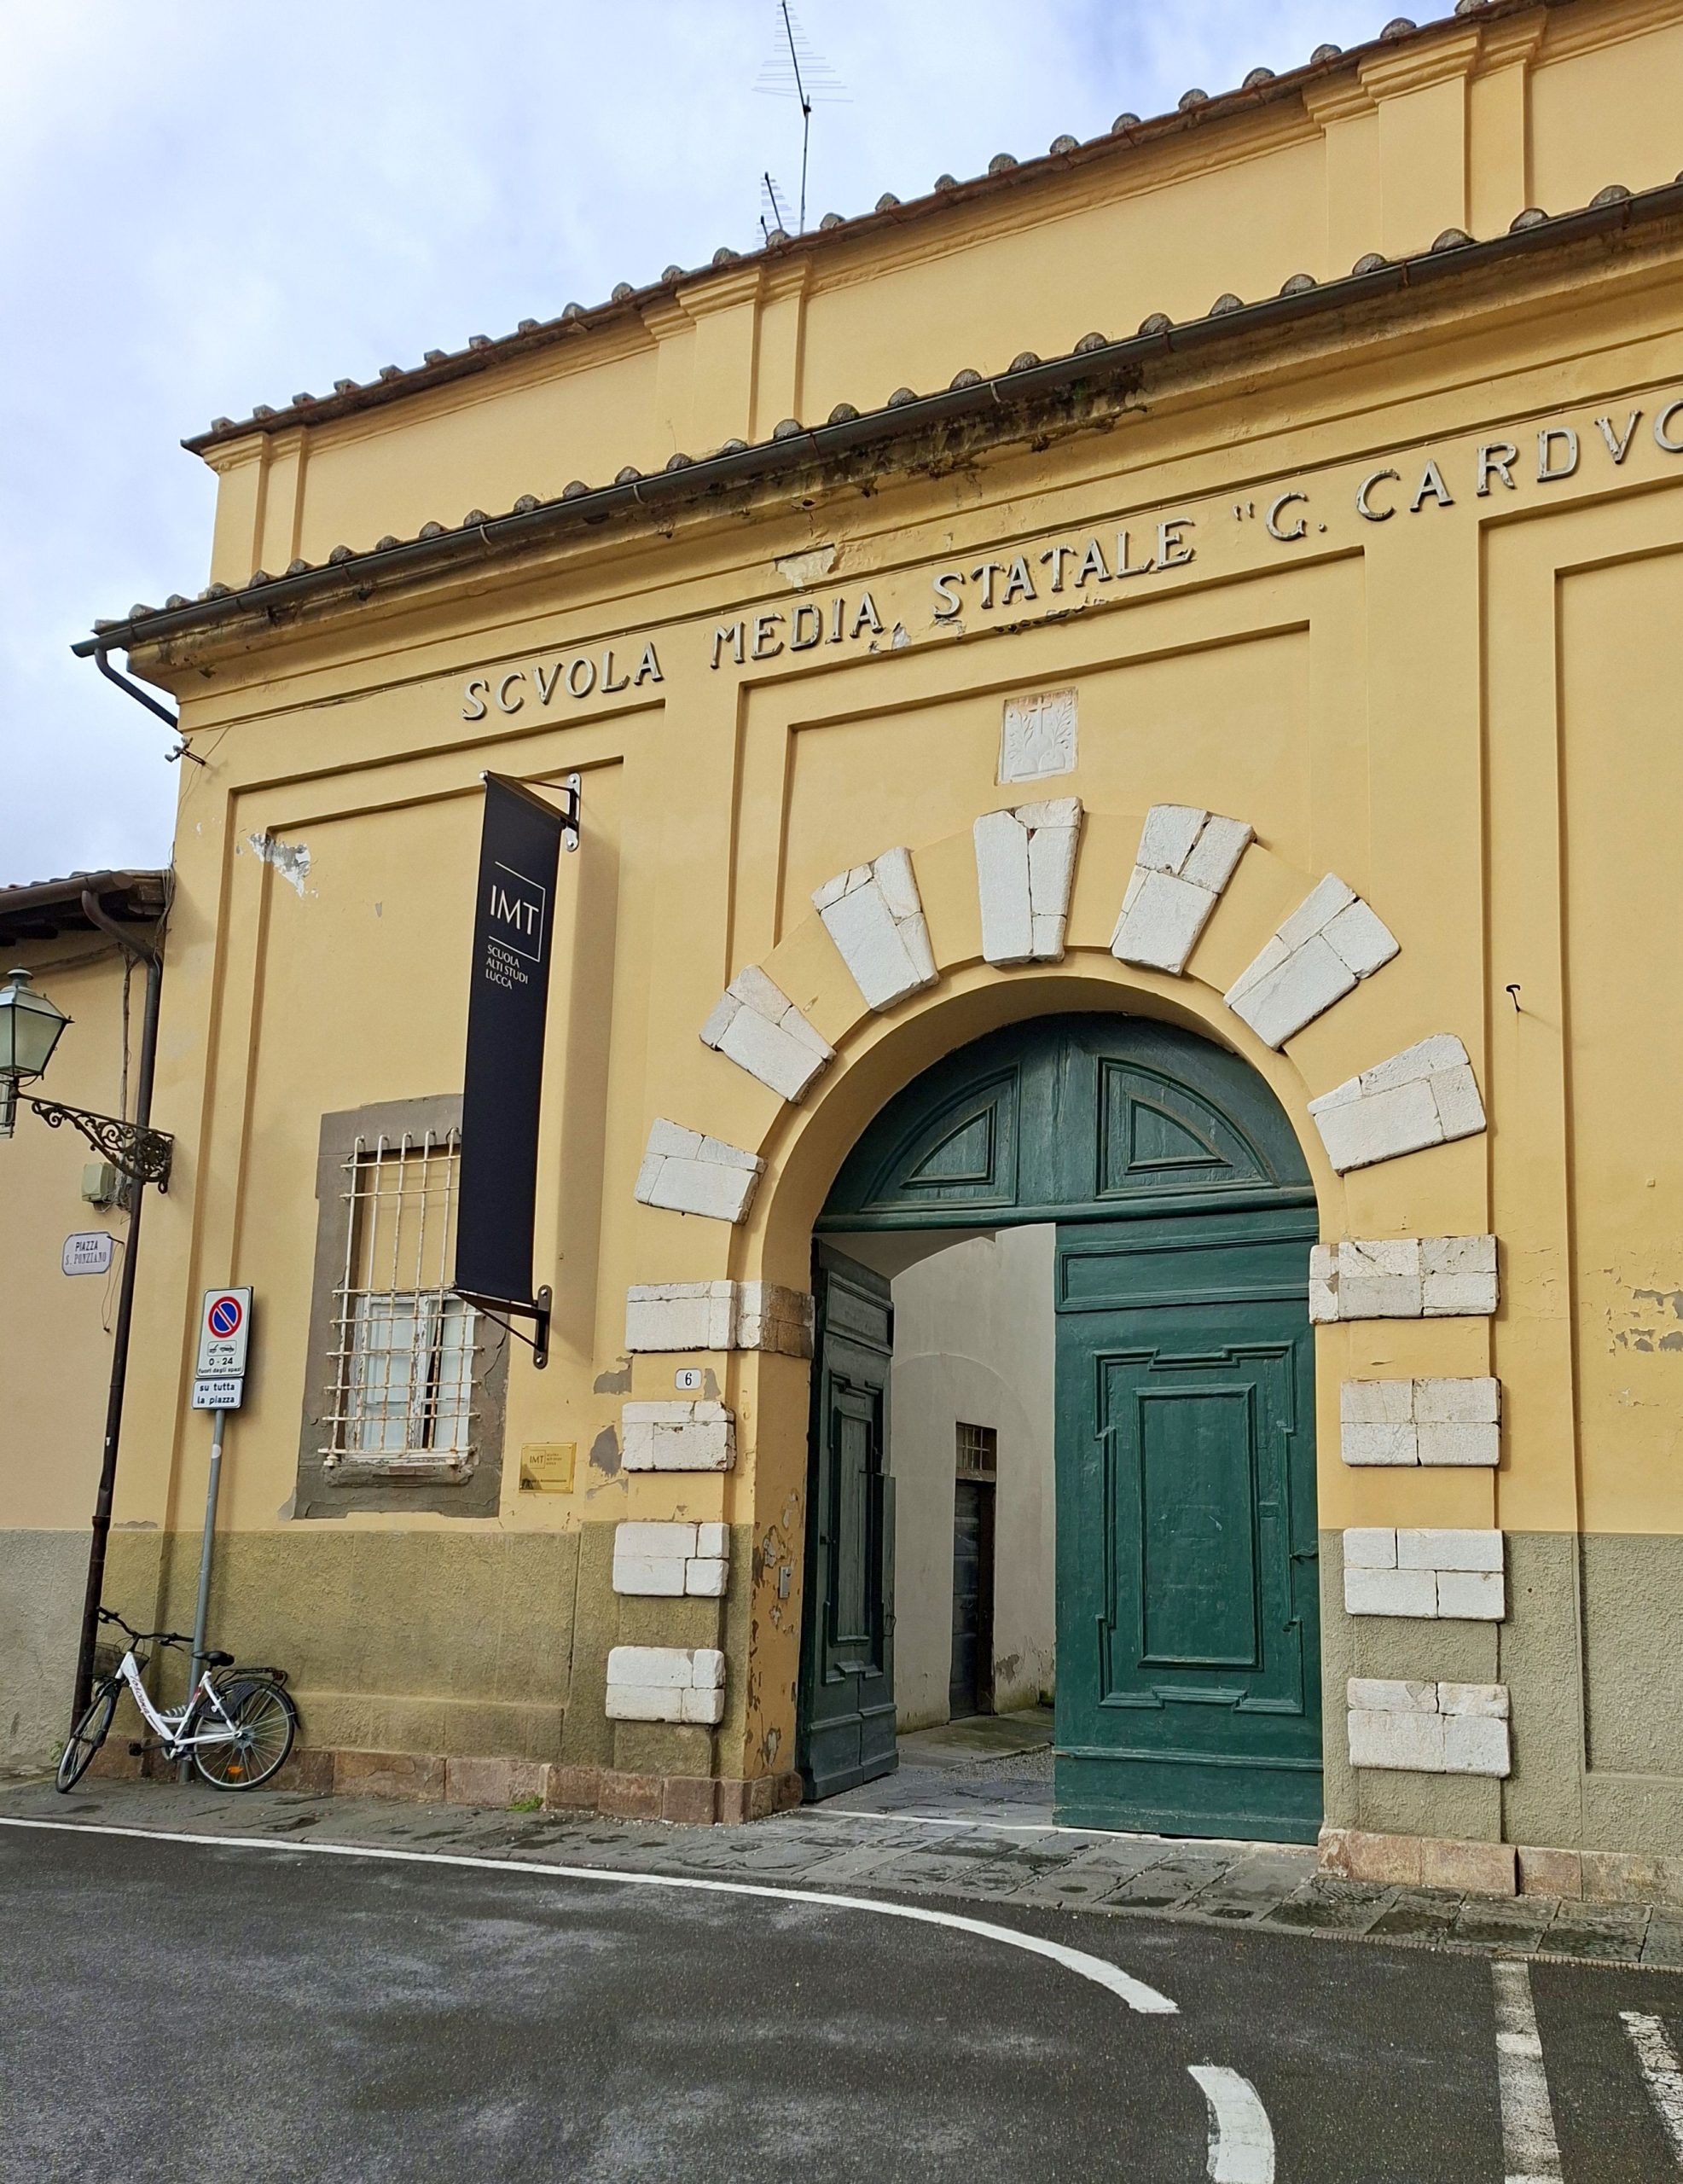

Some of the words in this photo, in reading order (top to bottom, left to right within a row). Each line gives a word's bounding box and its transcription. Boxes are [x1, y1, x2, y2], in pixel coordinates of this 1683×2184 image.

[462, 642, 664, 720] SCVOLA
[711, 592, 884, 669] MEDIA
[932, 517, 1196, 619] STATALE
[490, 884, 540, 935] IMT
[487, 944, 519, 968] SCUOLA
[486, 957, 502, 972] ALTI
[504, 966, 528, 984] STUDI
[486, 968, 512, 990] LUCCA
[75, 1240, 98, 1252] PIAZZA
[65, 1254, 73, 1265] S.
[74, 1252, 107, 1264] PONZIANO
[685, 1372, 693, 1386] 6
[213, 1383, 235, 1391] tutta
[197, 1396, 205, 1404] la
[209, 1395, 235, 1405] piazza
[529, 1455, 544, 1464] IMT
